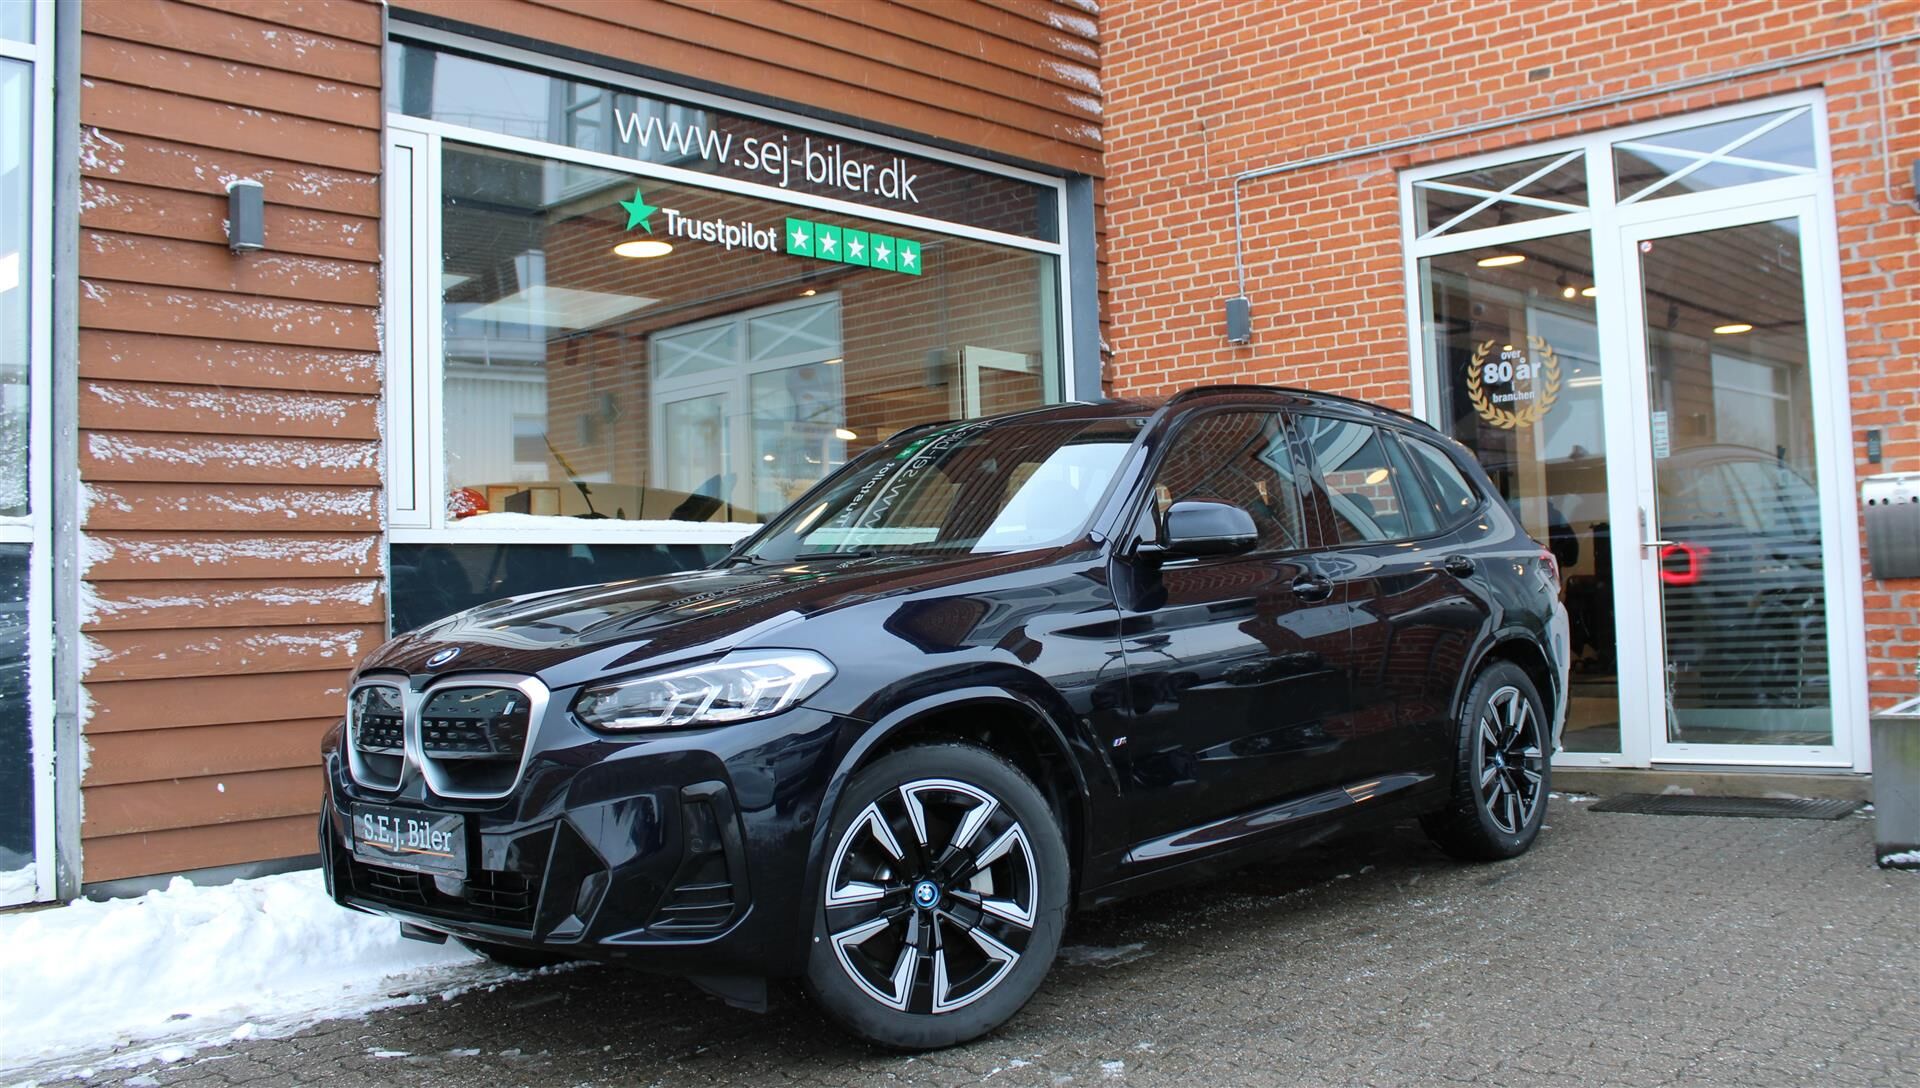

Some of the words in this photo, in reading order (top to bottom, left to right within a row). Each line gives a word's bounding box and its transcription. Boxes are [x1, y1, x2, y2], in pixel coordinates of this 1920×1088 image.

[614, 108, 919, 204] www.sej-biler.dk
[662, 207, 778, 252] Trustpilot
[1484, 361, 1513, 384] 80
[1515, 357, 1541, 380] år
[1501, 350, 1521, 360] over
[1492, 391, 1535, 403] branchen
[363, 813, 405, 852] S.E.J.
[407, 819, 452, 852] Biler
